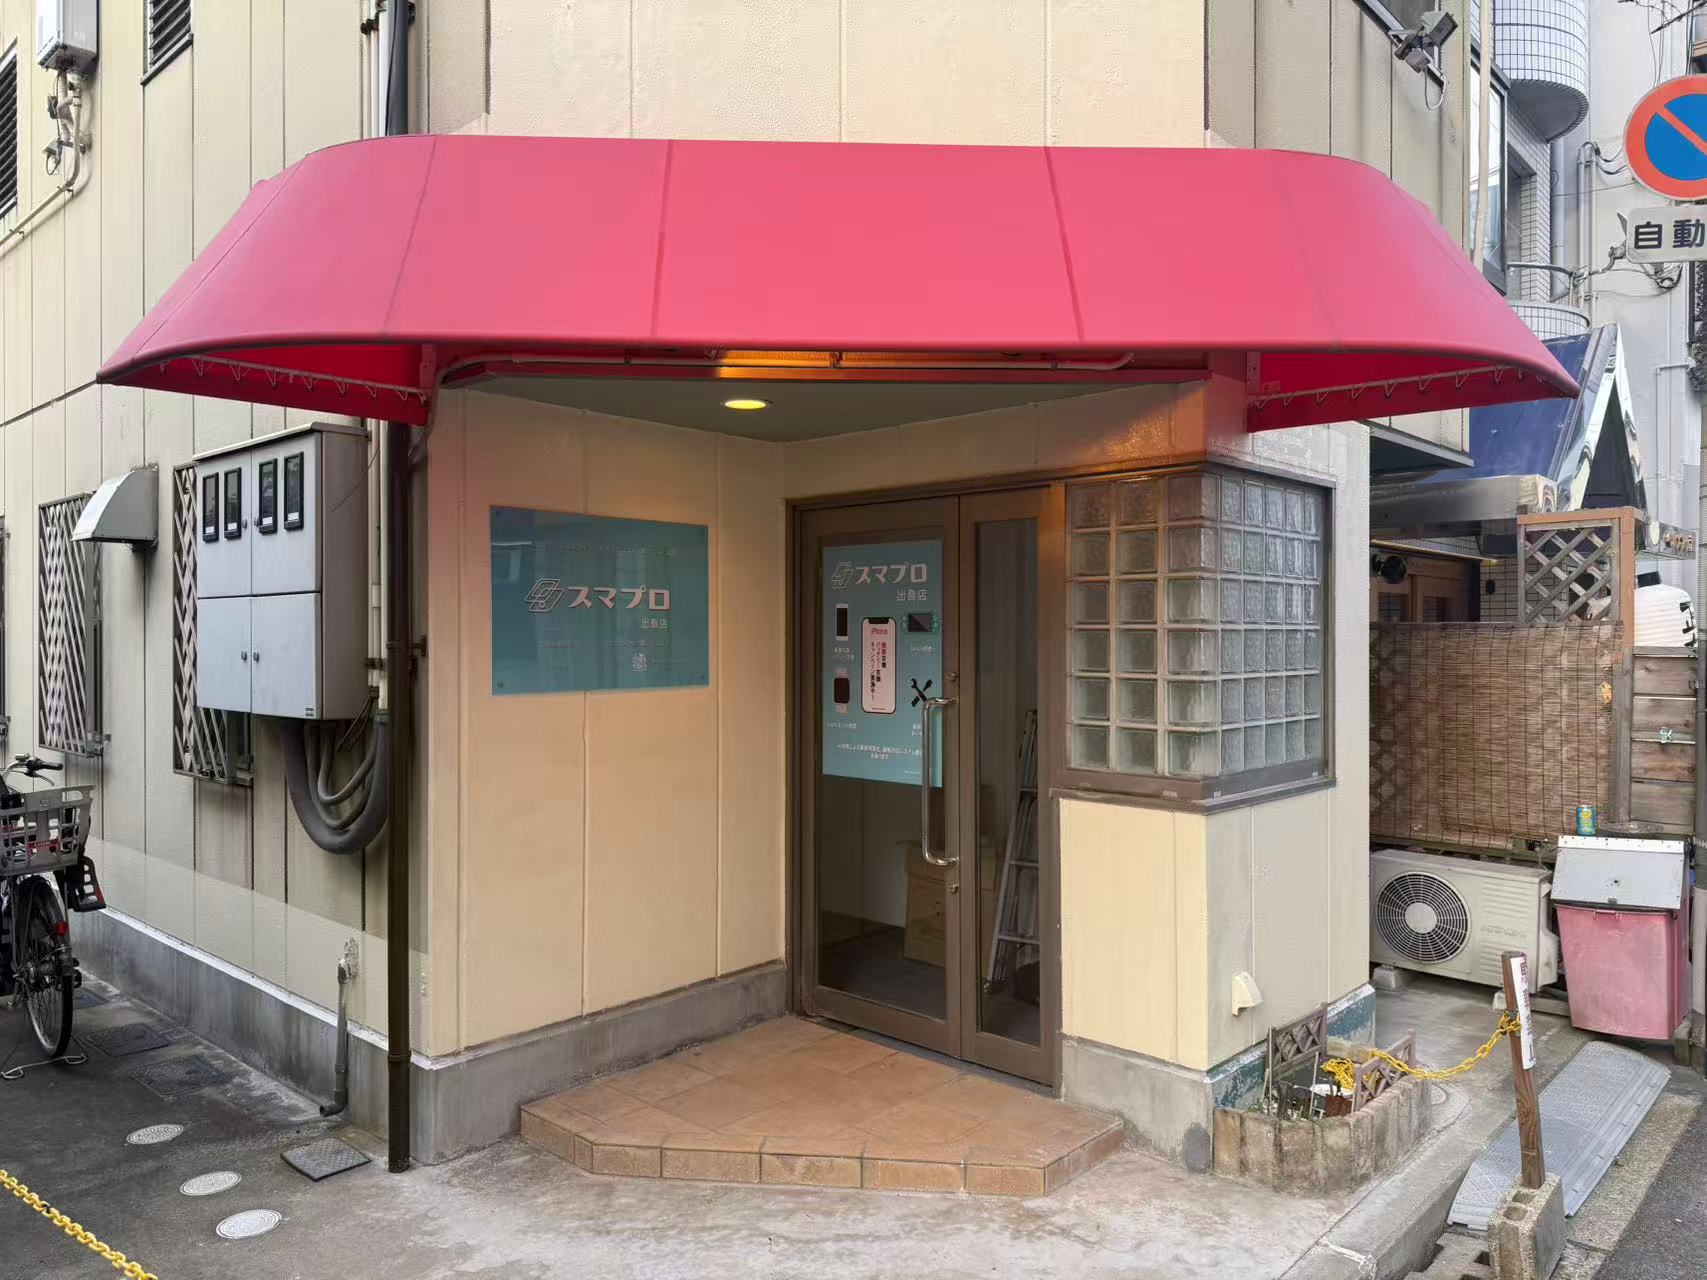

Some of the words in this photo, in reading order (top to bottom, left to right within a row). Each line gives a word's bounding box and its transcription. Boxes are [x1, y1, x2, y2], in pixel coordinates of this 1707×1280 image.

[1633, 218, 1705, 249] 自動
[855, 560, 928, 585] スマプロ
[567, 584, 672, 611] スマプロ
